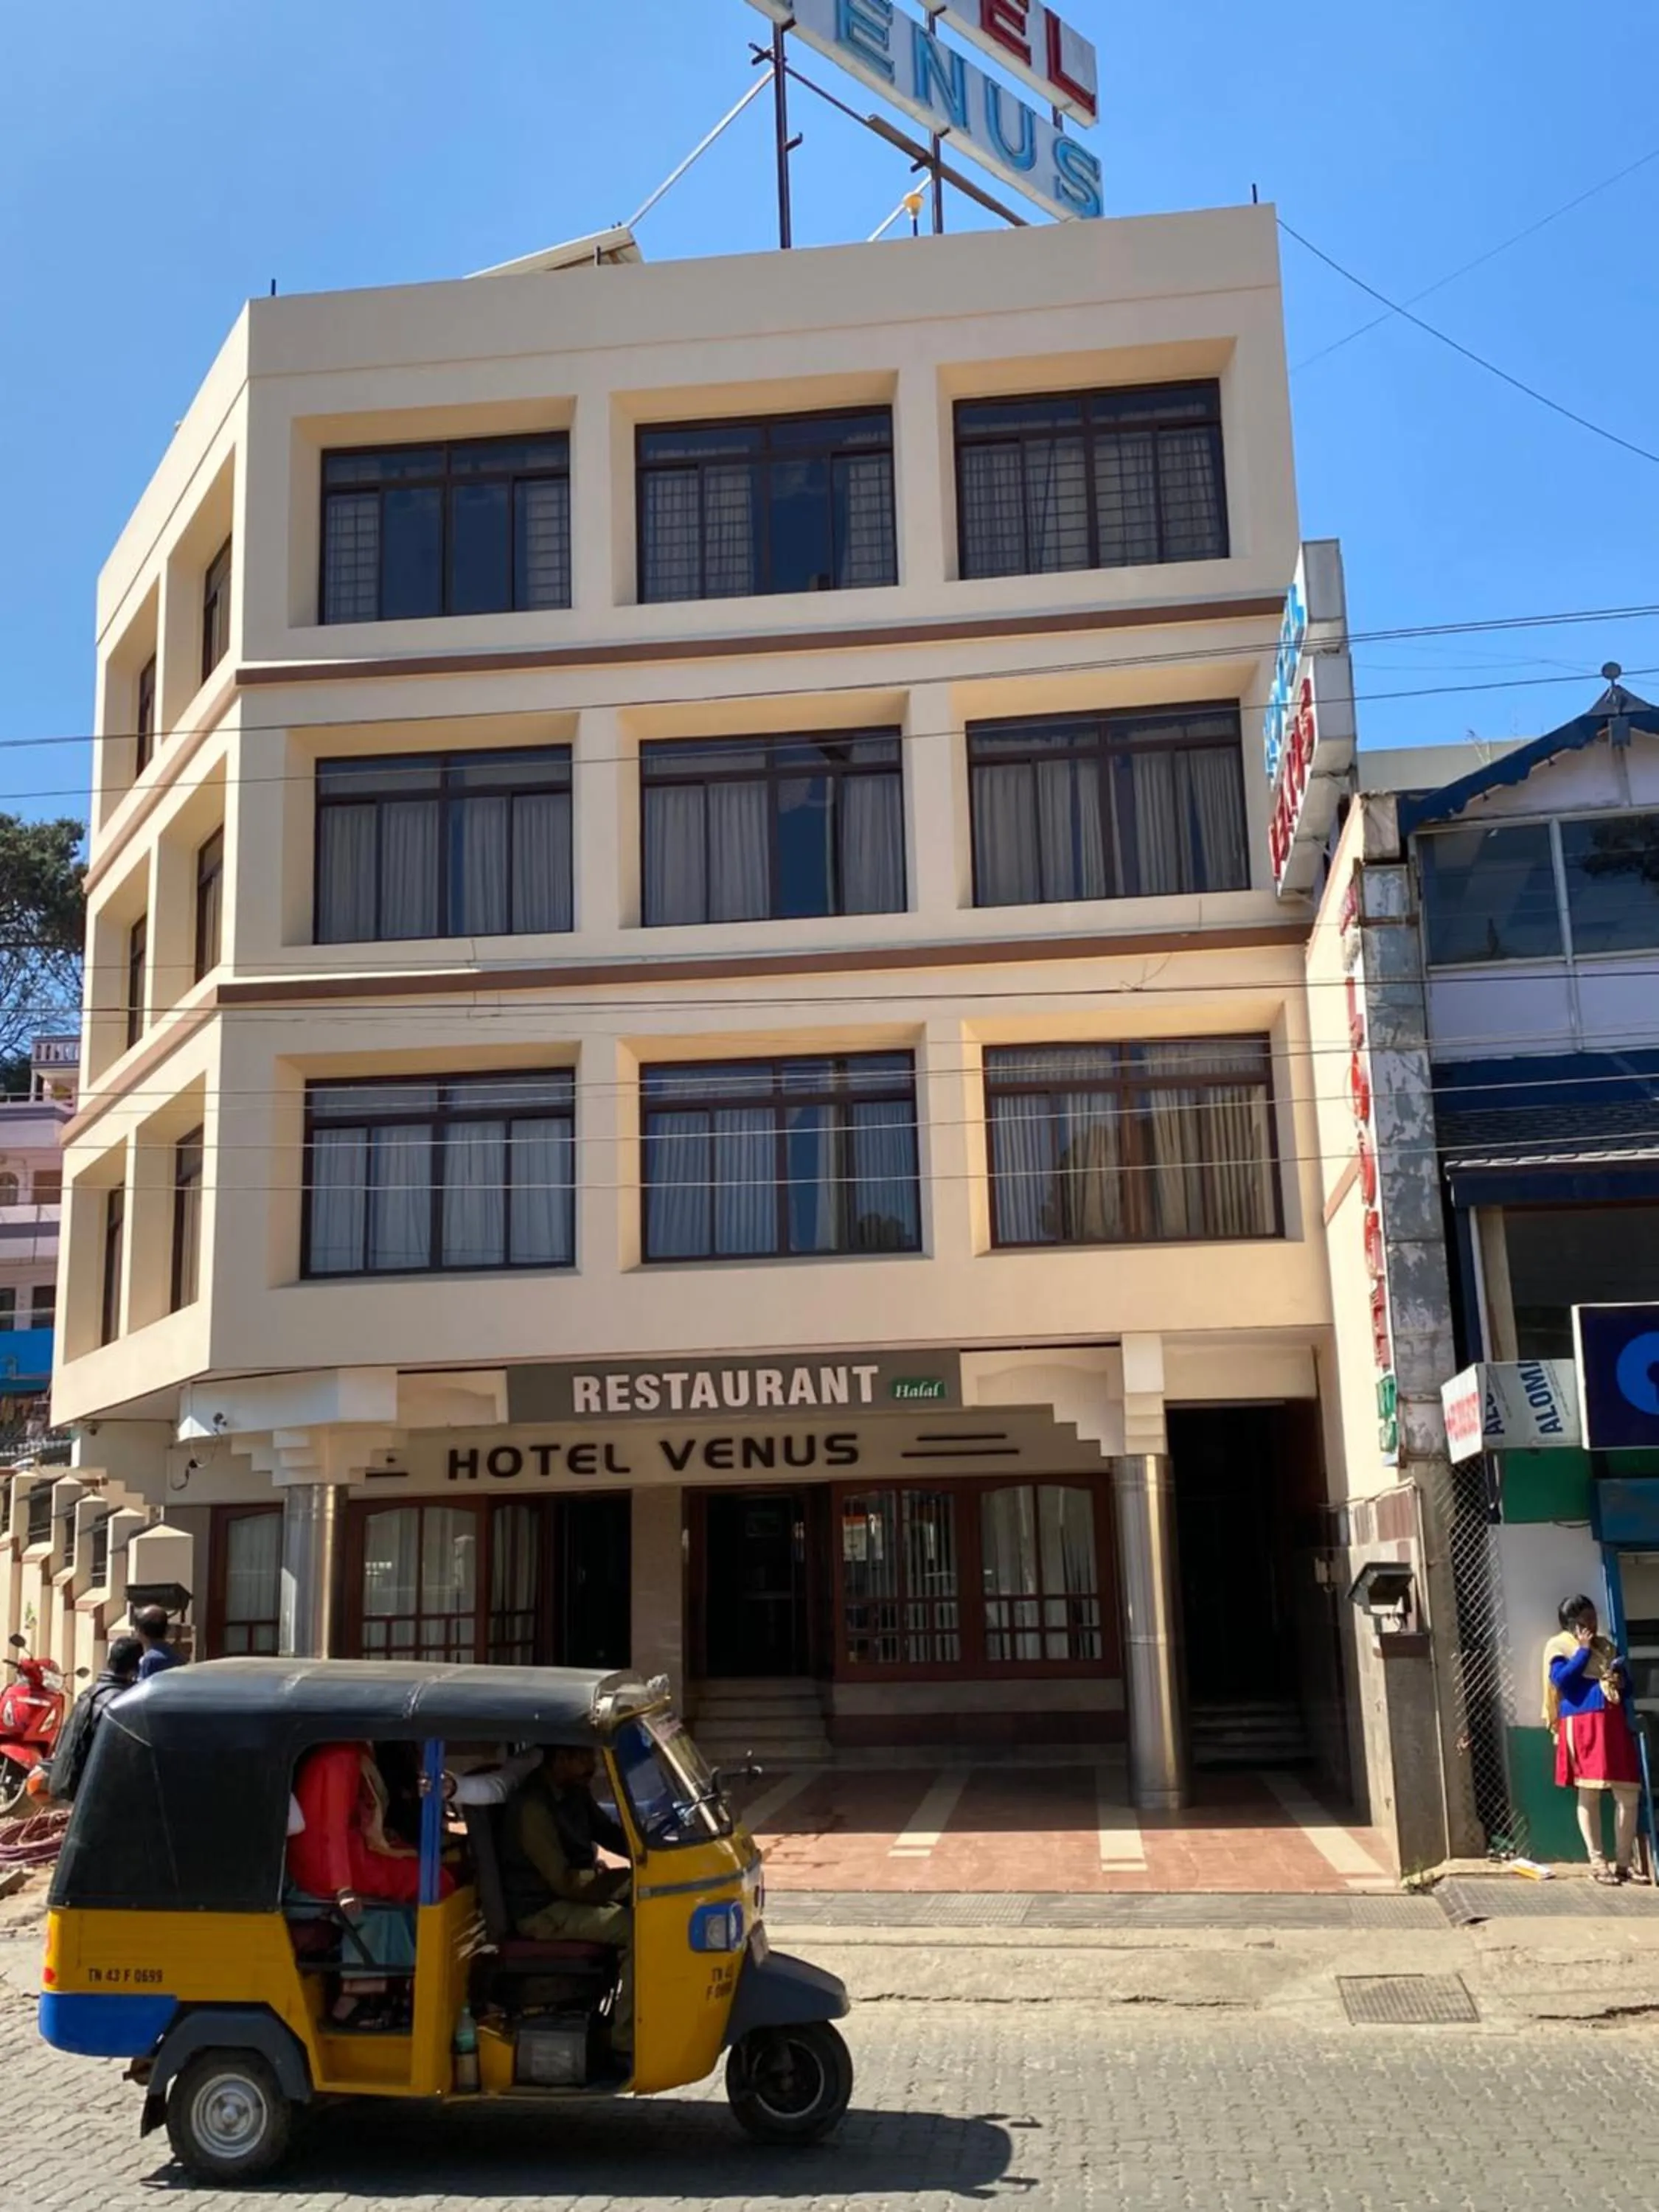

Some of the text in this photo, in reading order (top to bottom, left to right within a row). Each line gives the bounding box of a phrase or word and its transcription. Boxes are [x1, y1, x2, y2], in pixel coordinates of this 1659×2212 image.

[779, 0, 1103, 218] ENUS
[572, 1366, 879, 1413] RESTAURANT
[896, 1381, 942, 1398] Halal
[448, 1433, 859, 1480] HOTEL VENUS
[88, 1969, 102, 1982] TN
[124, 1969, 131, 1982] F
